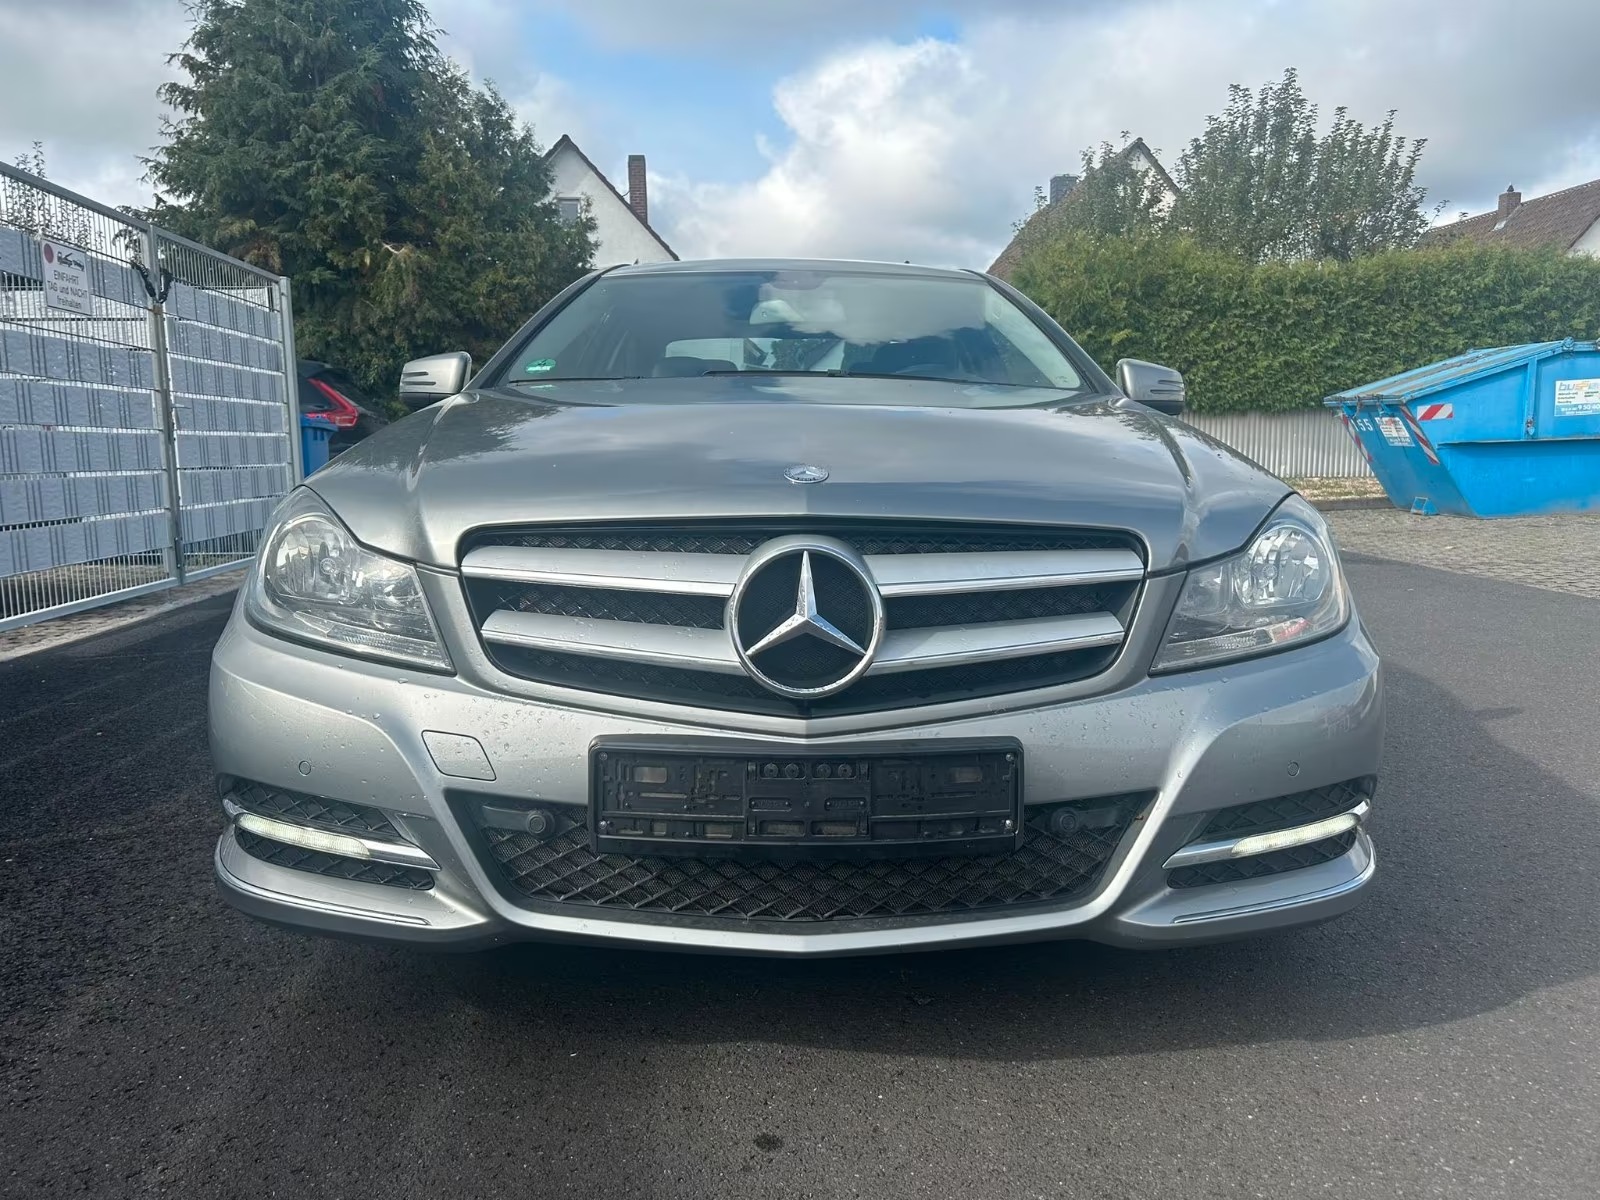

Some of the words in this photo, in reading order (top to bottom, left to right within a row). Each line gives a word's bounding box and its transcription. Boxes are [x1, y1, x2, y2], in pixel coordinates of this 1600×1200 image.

[54, 270, 79, 285] EINFAHRT
[47, 280, 58, 292] TAG
[60, 286, 69, 295] und
[70, 286, 88, 299] NACHT
[57, 296, 81, 308] freihalten
